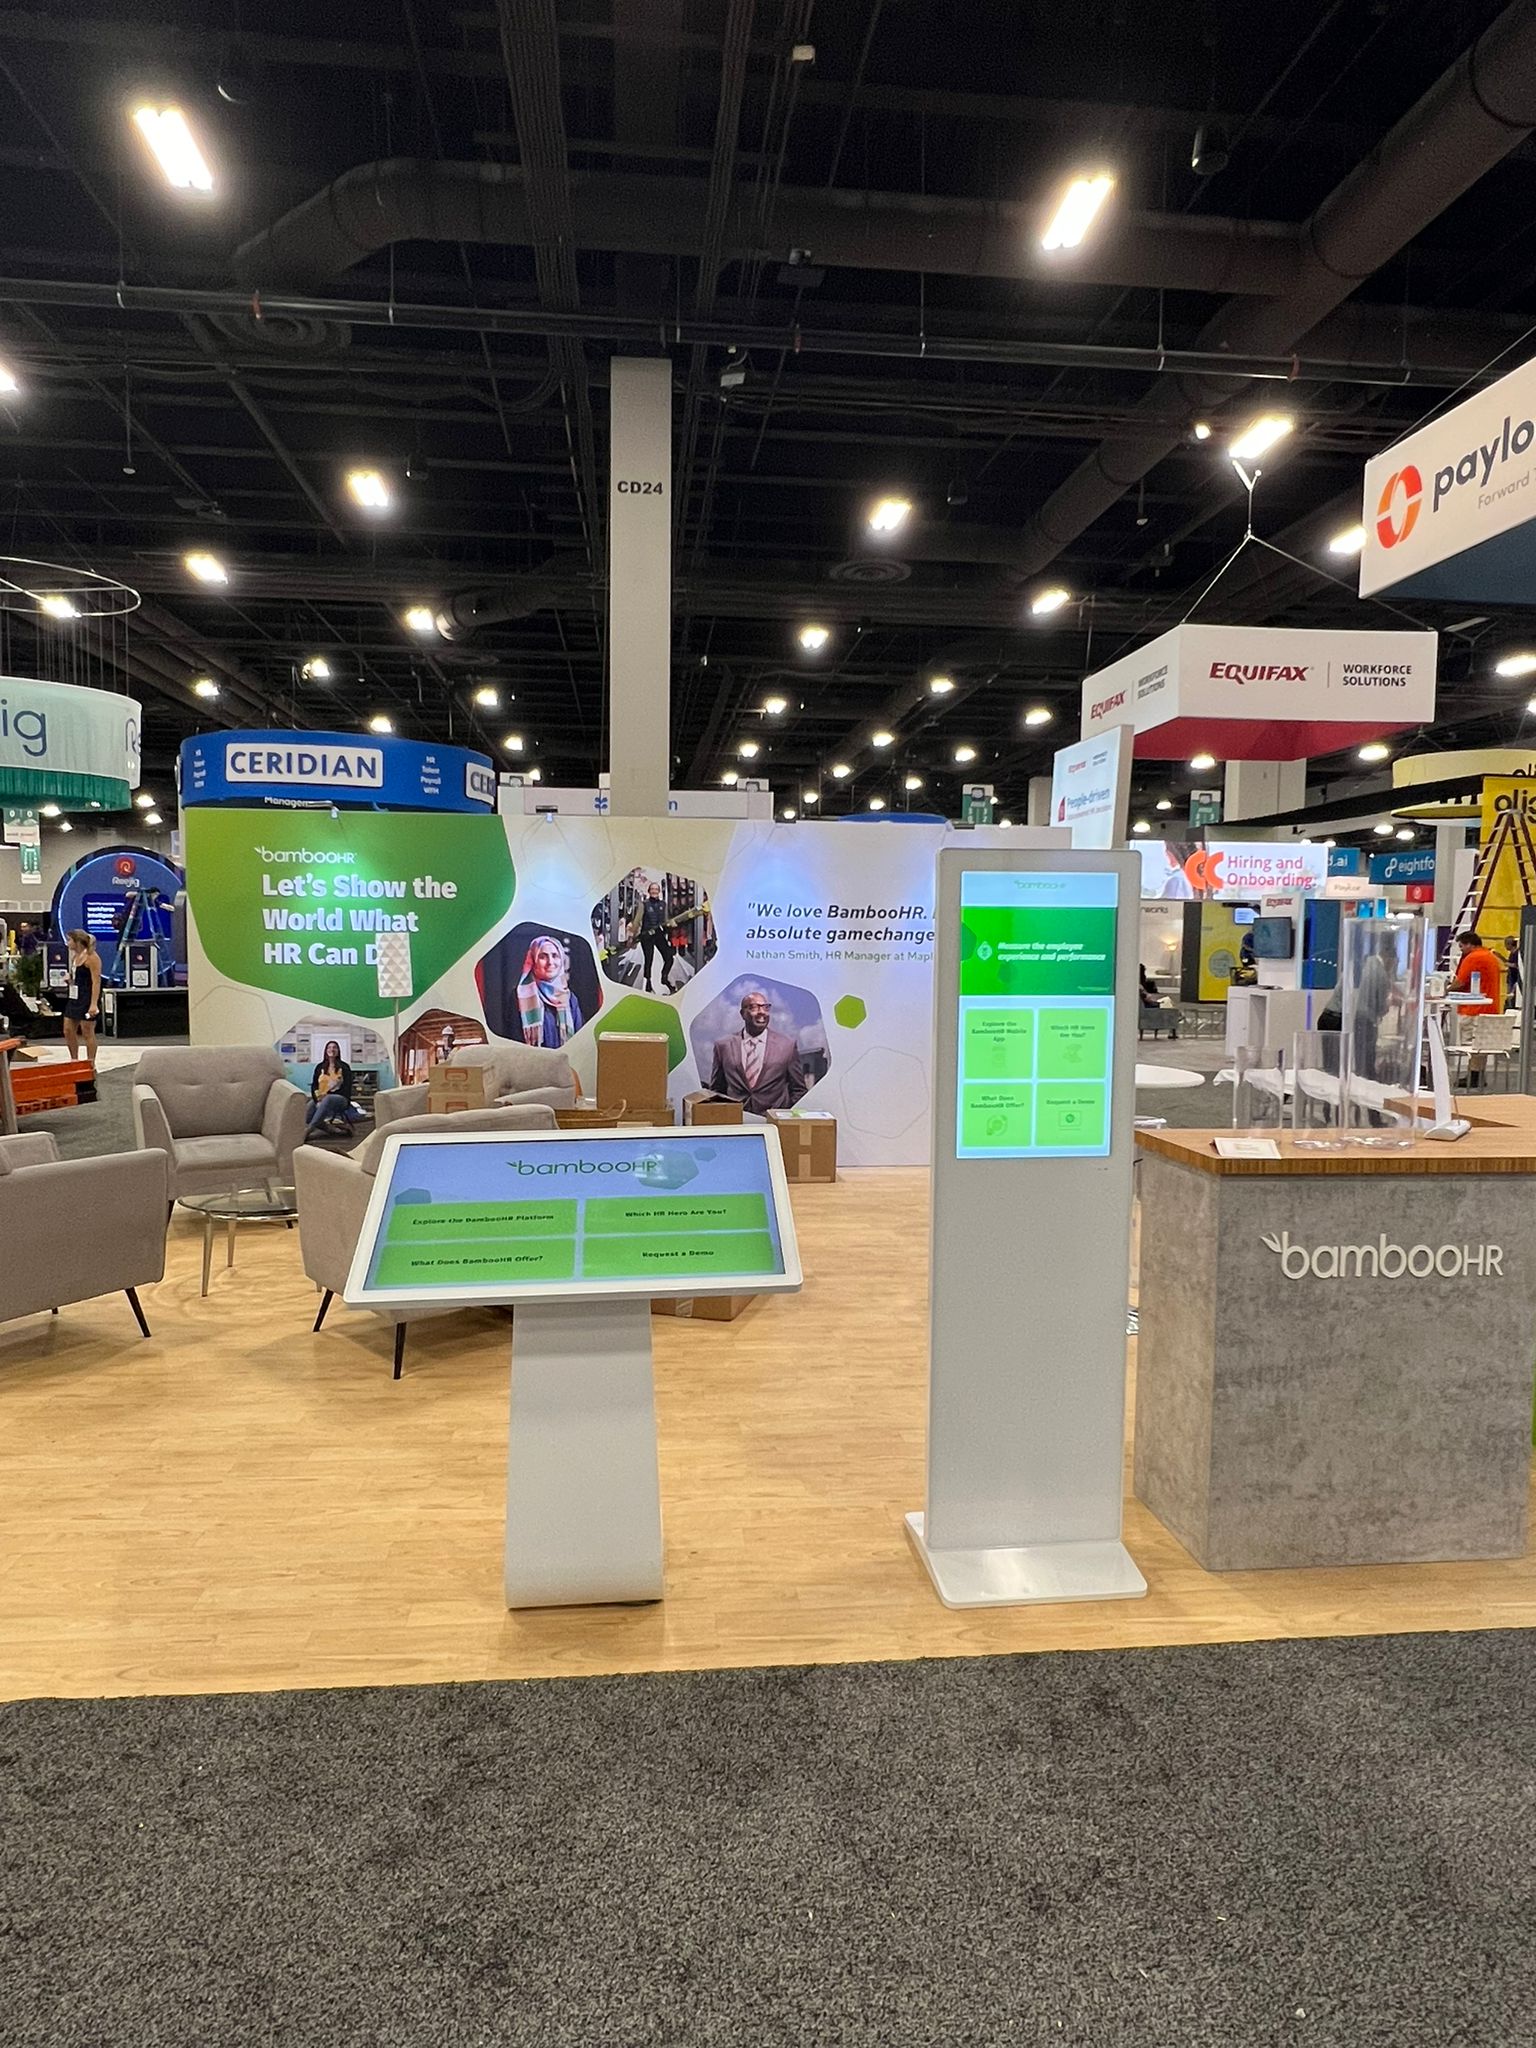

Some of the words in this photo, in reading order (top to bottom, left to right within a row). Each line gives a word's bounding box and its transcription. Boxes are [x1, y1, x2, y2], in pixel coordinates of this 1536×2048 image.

[617, 481, 663, 495] CD24
[1478, 471, 1530, 509] Forward
[1209, 662, 1309, 685] EQUIFAX
[1343, 664, 1412, 675] WORKFORCE
[1343, 676, 1406, 687] SOLUTIONS
[1091, 689, 1127, 719] EQUIFAX
[230, 751, 377, 779] CERIDIAN
[470, 771, 497, 797] CER
[261, 846, 355, 864] bambooHR
[1227, 856, 1272, 873] Hiring
[1276, 856, 1304, 869] and
[333, 874, 406, 898] Show
[413, 875, 458, 899] the
[262, 908, 343, 931] World
[350, 909, 420, 933] What
[787, 904, 823, 918] love
[827, 905, 928, 920] BambooHR.
[746, 925, 822, 941] absolute
[826, 926, 936, 945] gamechange
[264, 942, 302, 965] HR
[308, 943, 358, 965] Can
[365, 944, 378, 965] D
[746, 950, 786, 960] Nathan
[788, 950, 823, 961] Smith,
[825, 951, 842, 961] HR
[844, 951, 891, 963] Manager
[894, 953, 905, 961] at
[907, 951, 933, 963] Mapl
[411, 1259, 435, 1267] What
[462, 1256, 512, 1265] BambooHR
[515, 1255, 543, 1263] Offer?
[642, 1251, 679, 1259] Request
[1280, 1231, 1503, 1280] bambooHR
